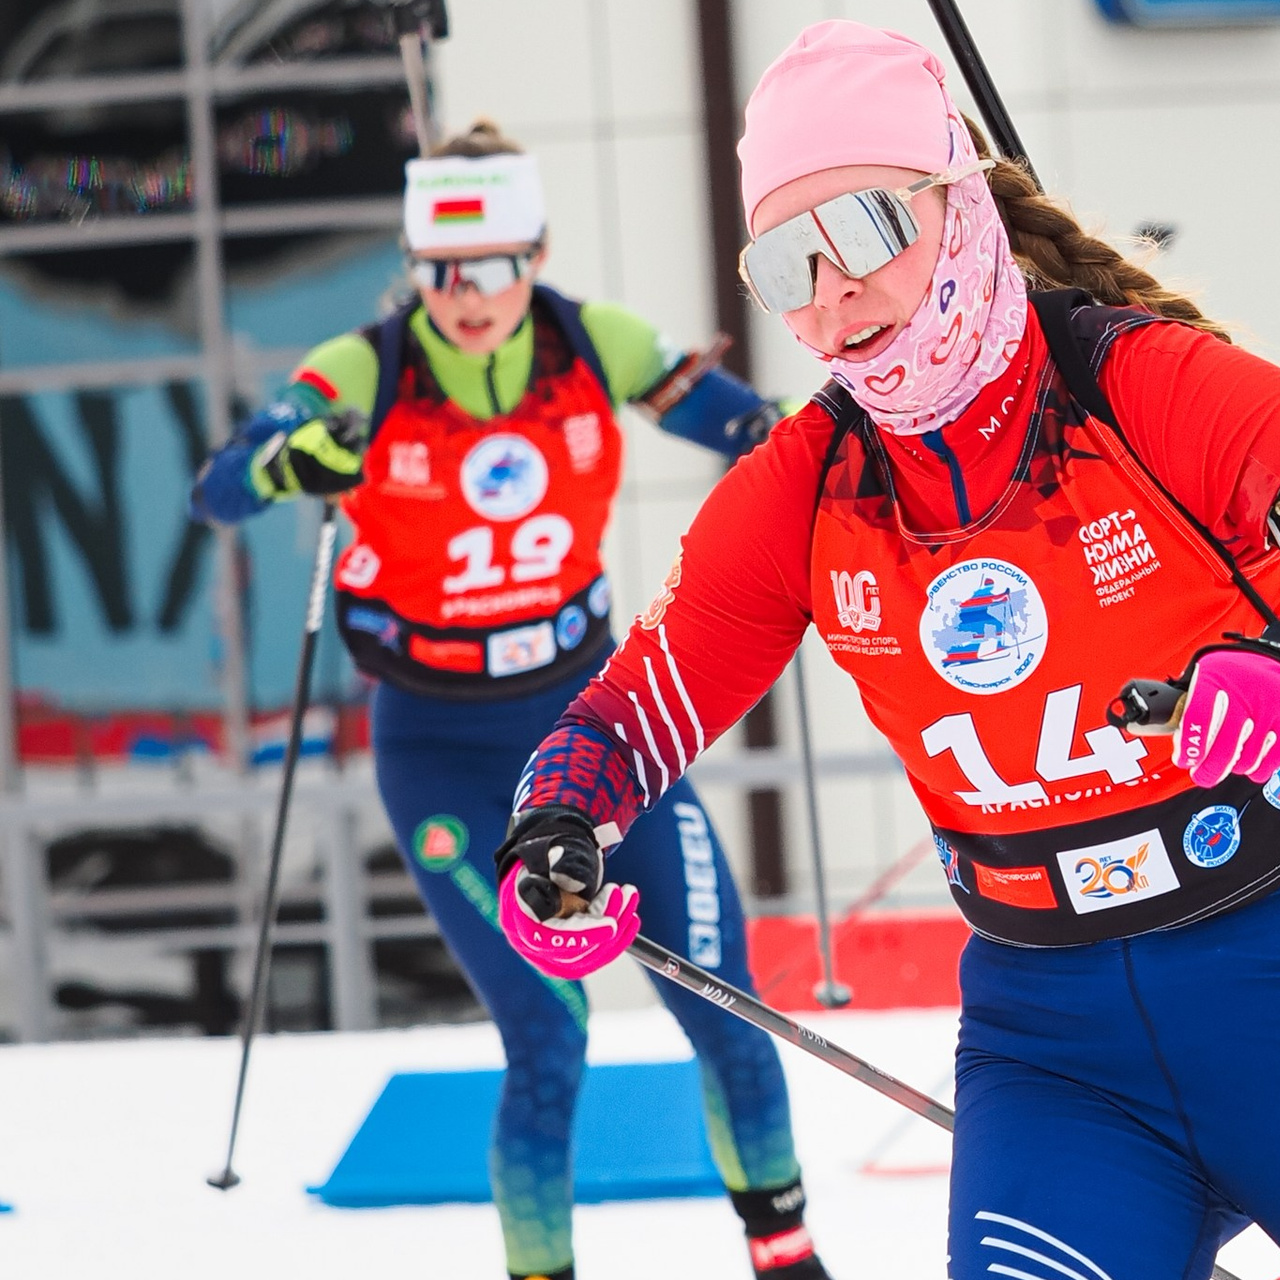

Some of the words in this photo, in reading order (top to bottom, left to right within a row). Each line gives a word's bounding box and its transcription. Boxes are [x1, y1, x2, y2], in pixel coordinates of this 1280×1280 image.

[442, 513, 574, 595] 19
[1089, 541, 1156, 585] ЖИЗНИ
[981, 562, 1028, 586] РОССИИ
[1095, 560, 1162, 596] ФЕДЕРАЛЬНЫЙ
[1099, 586, 1136, 608] ПРОЕКТ
[954, 674, 1012, 689] Красноярск
[1013, 652, 1035, 676] 2023
[920, 682, 1149, 806] 14
